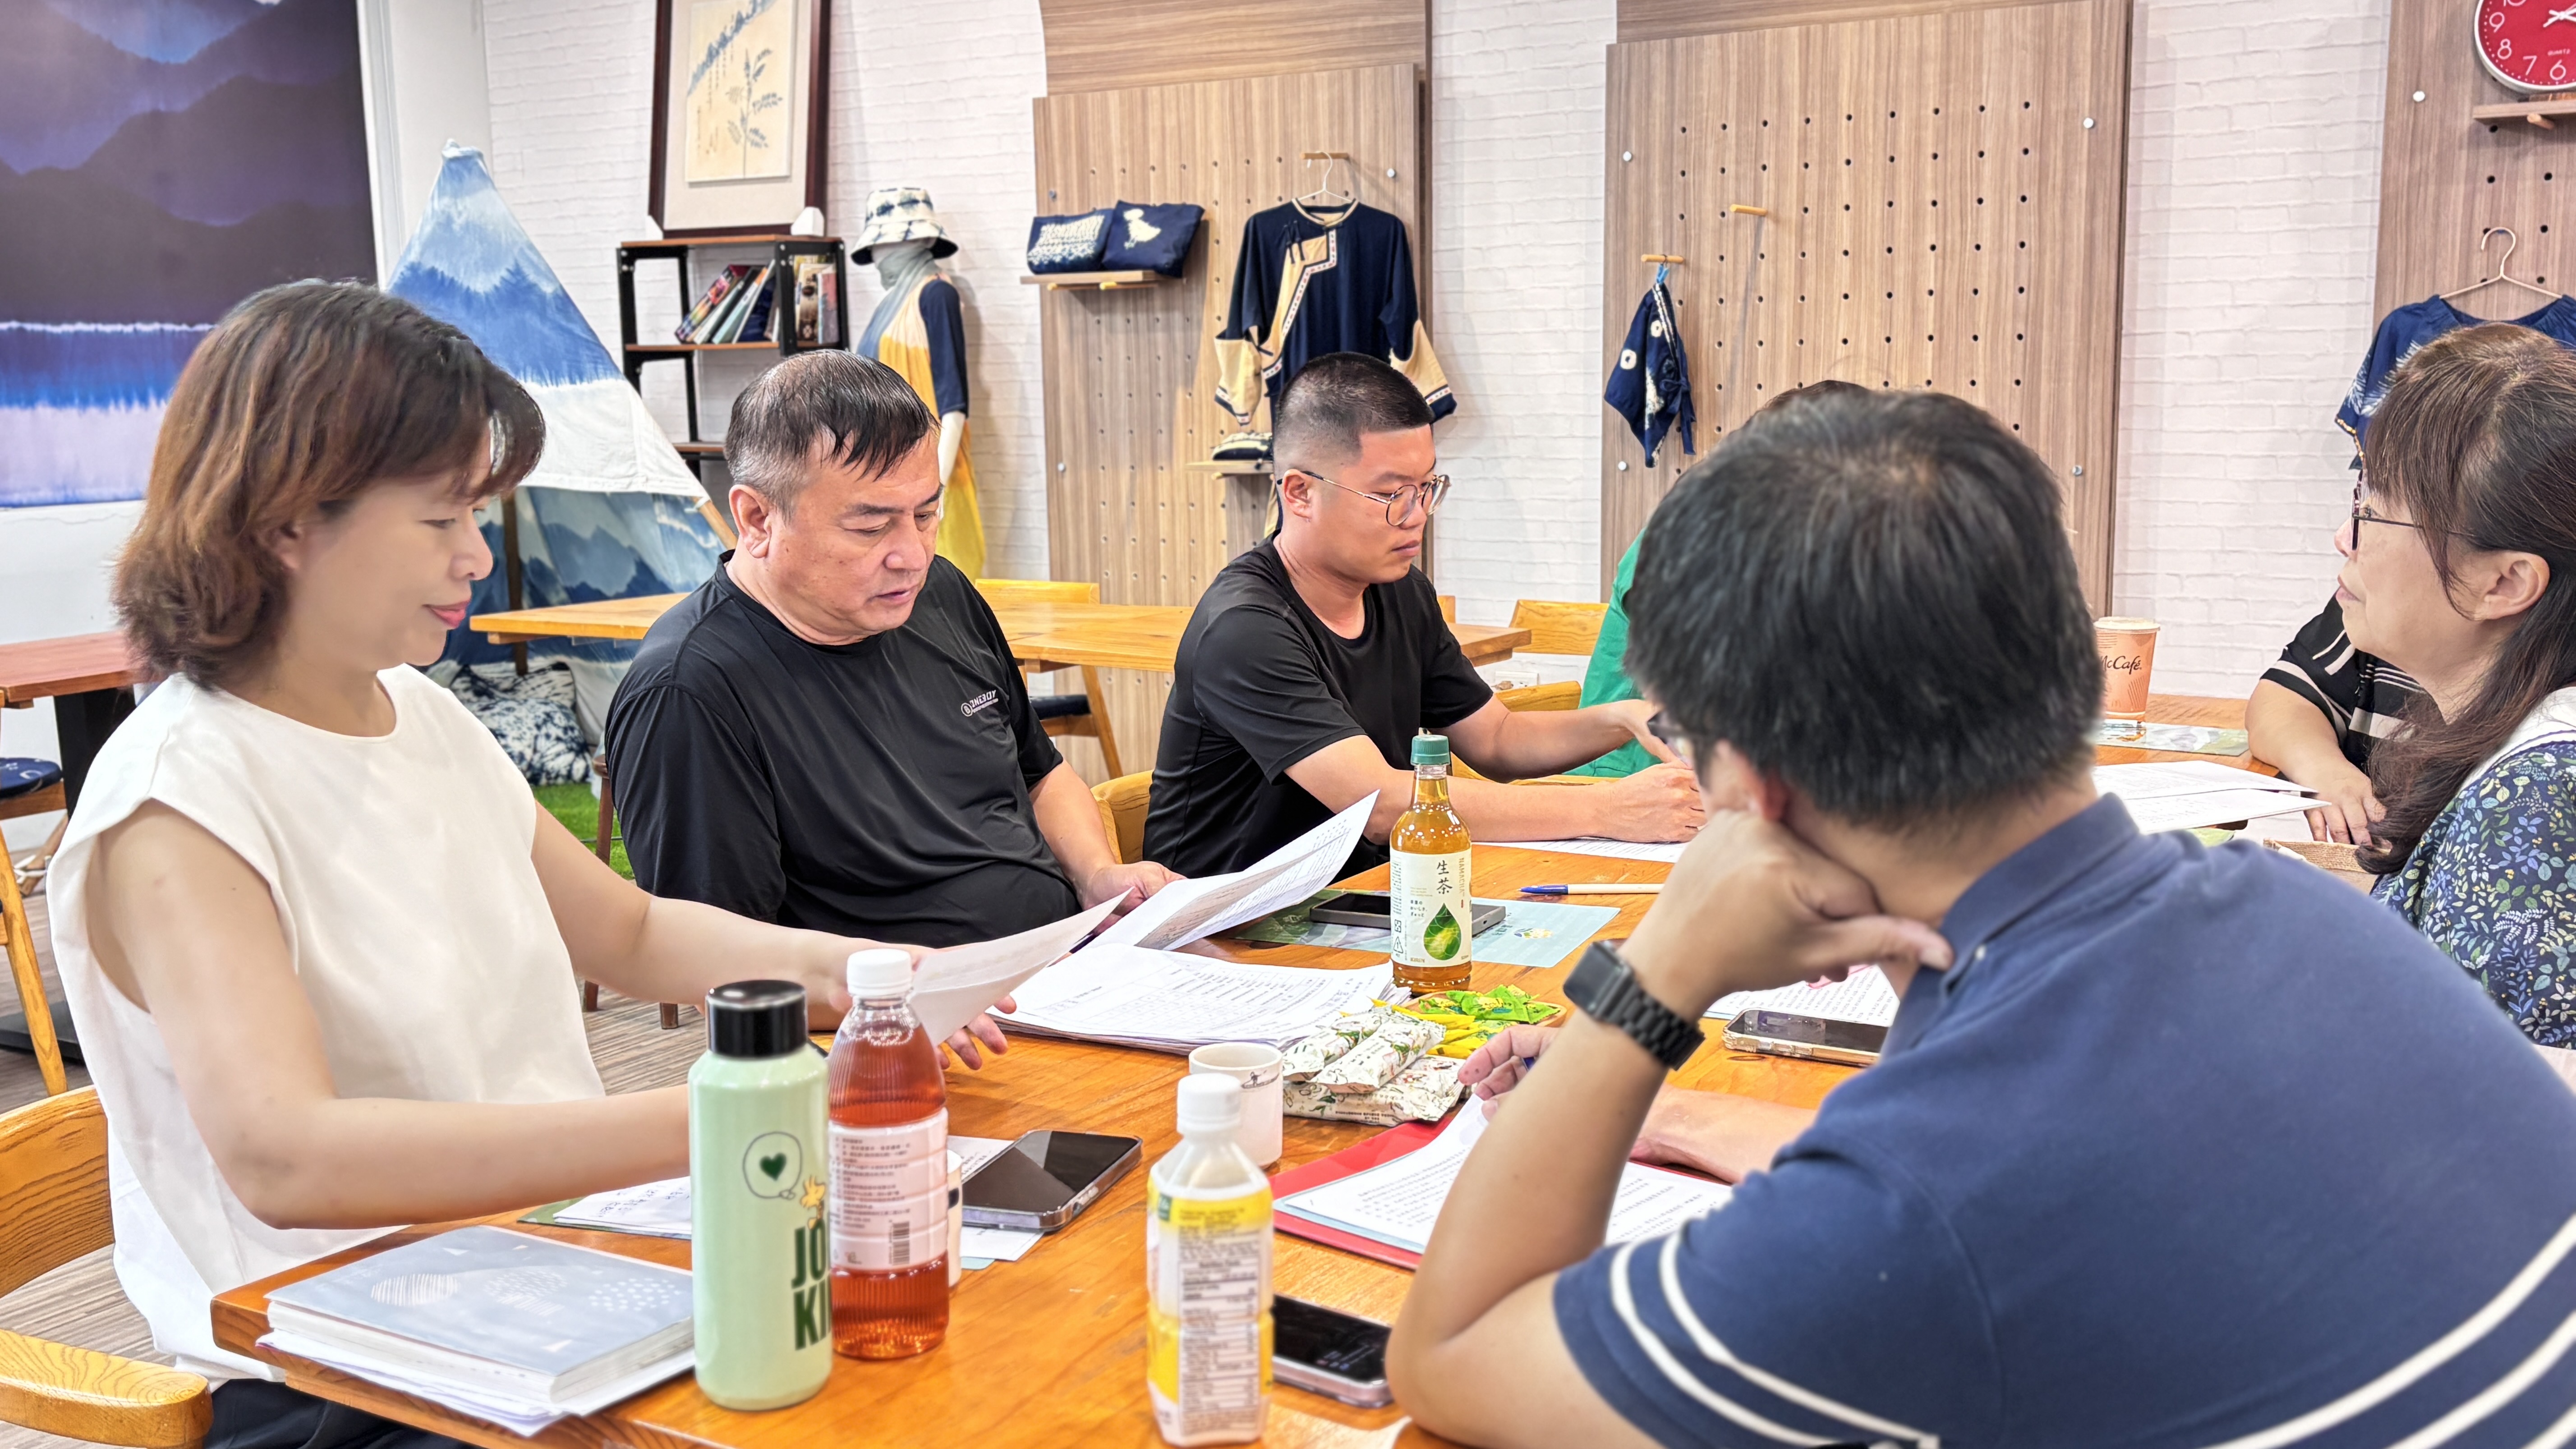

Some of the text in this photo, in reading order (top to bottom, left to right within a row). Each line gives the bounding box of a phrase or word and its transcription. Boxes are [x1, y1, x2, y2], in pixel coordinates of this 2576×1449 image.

[2489, 12, 2505, 33] 9
[2497, 38, 2512, 60] 8
[2523, 55, 2537, 76] 7
[2549, 60, 2566, 80] 6
[1436, 860, 1453, 894] 生茶
[791, 1215, 830, 1289] JO
[794, 1275, 831, 1351] KI
